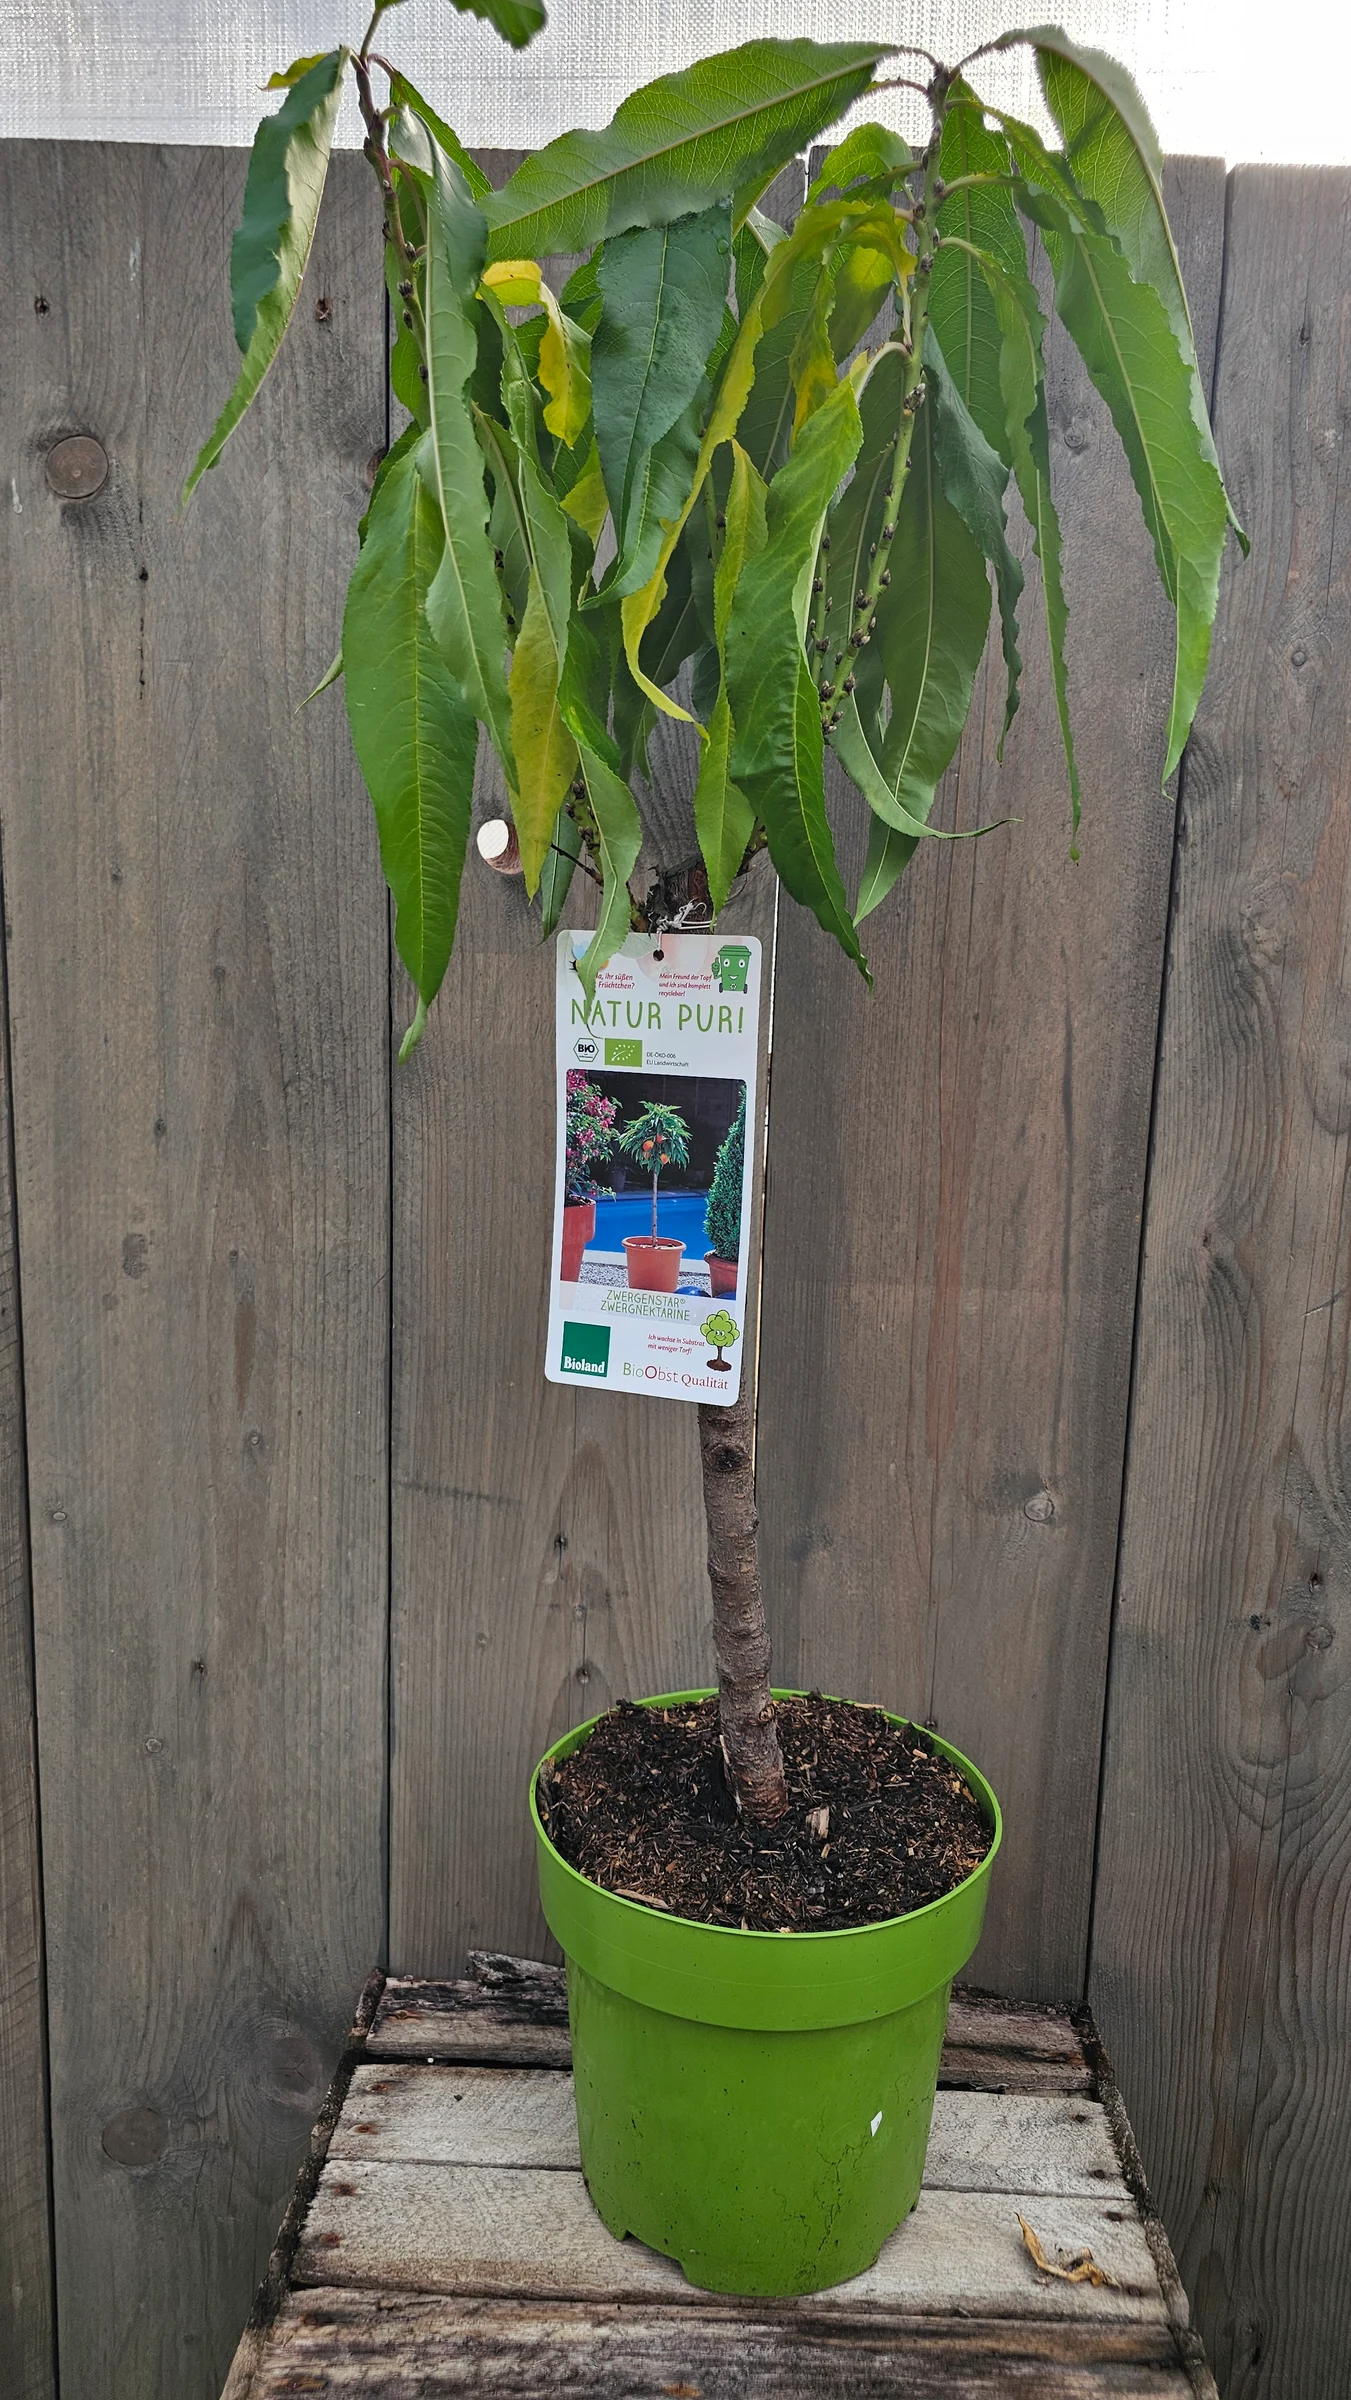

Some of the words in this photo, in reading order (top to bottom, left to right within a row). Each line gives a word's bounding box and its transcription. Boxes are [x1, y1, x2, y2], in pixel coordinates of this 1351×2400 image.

[615, 974, 633, 982] süßen
[572, 998, 661, 1029] NATUR
[678, 1004, 744, 1033] PUR!
[600, 1300, 690, 1321] ZWERGNEKTARINE
[682, 1338, 705, 1346] Substrat
[564, 1356, 605, 1374] Bioland
[681, 1373, 728, 1390] Qualität
